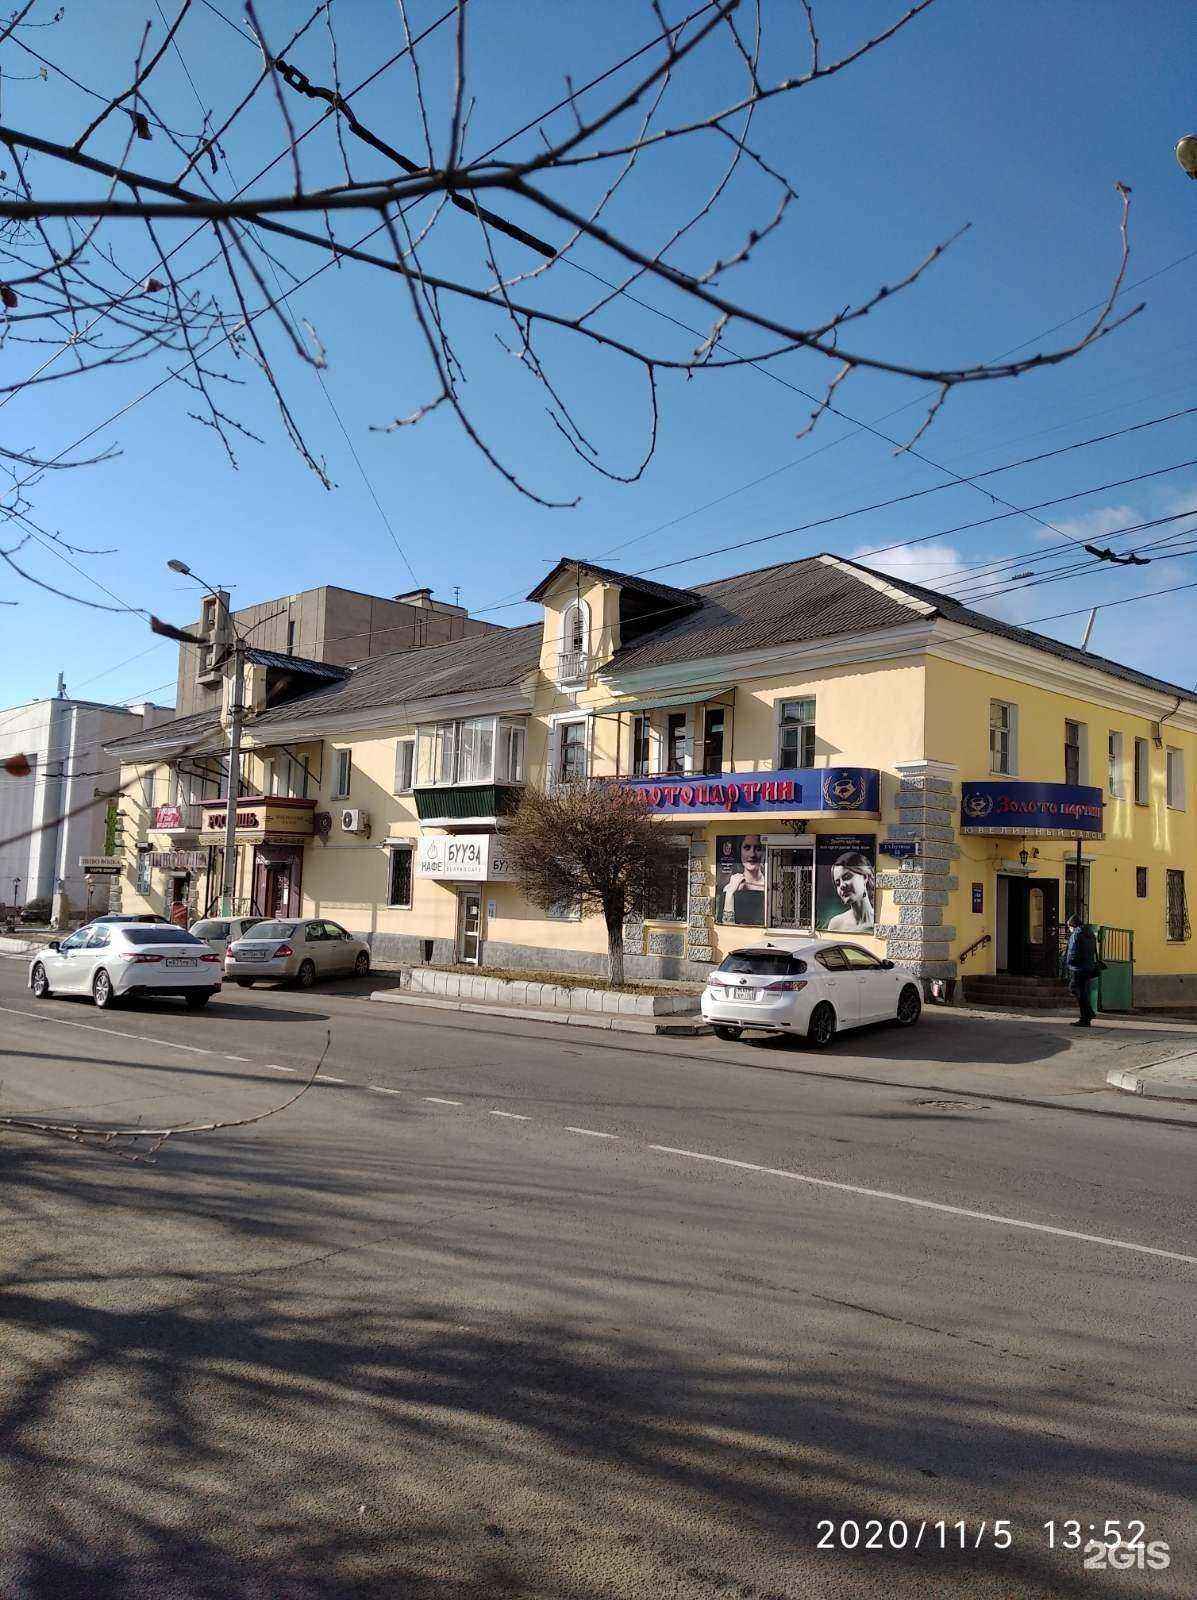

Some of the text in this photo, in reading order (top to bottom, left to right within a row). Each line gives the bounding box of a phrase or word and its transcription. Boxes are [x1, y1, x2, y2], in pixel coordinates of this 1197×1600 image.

[964, 826, 1064, 837] ЮВЕЛИРНЫЙ
[448, 843, 481, 865] БУУЗА
[421, 861, 444, 871] КАФЕ
